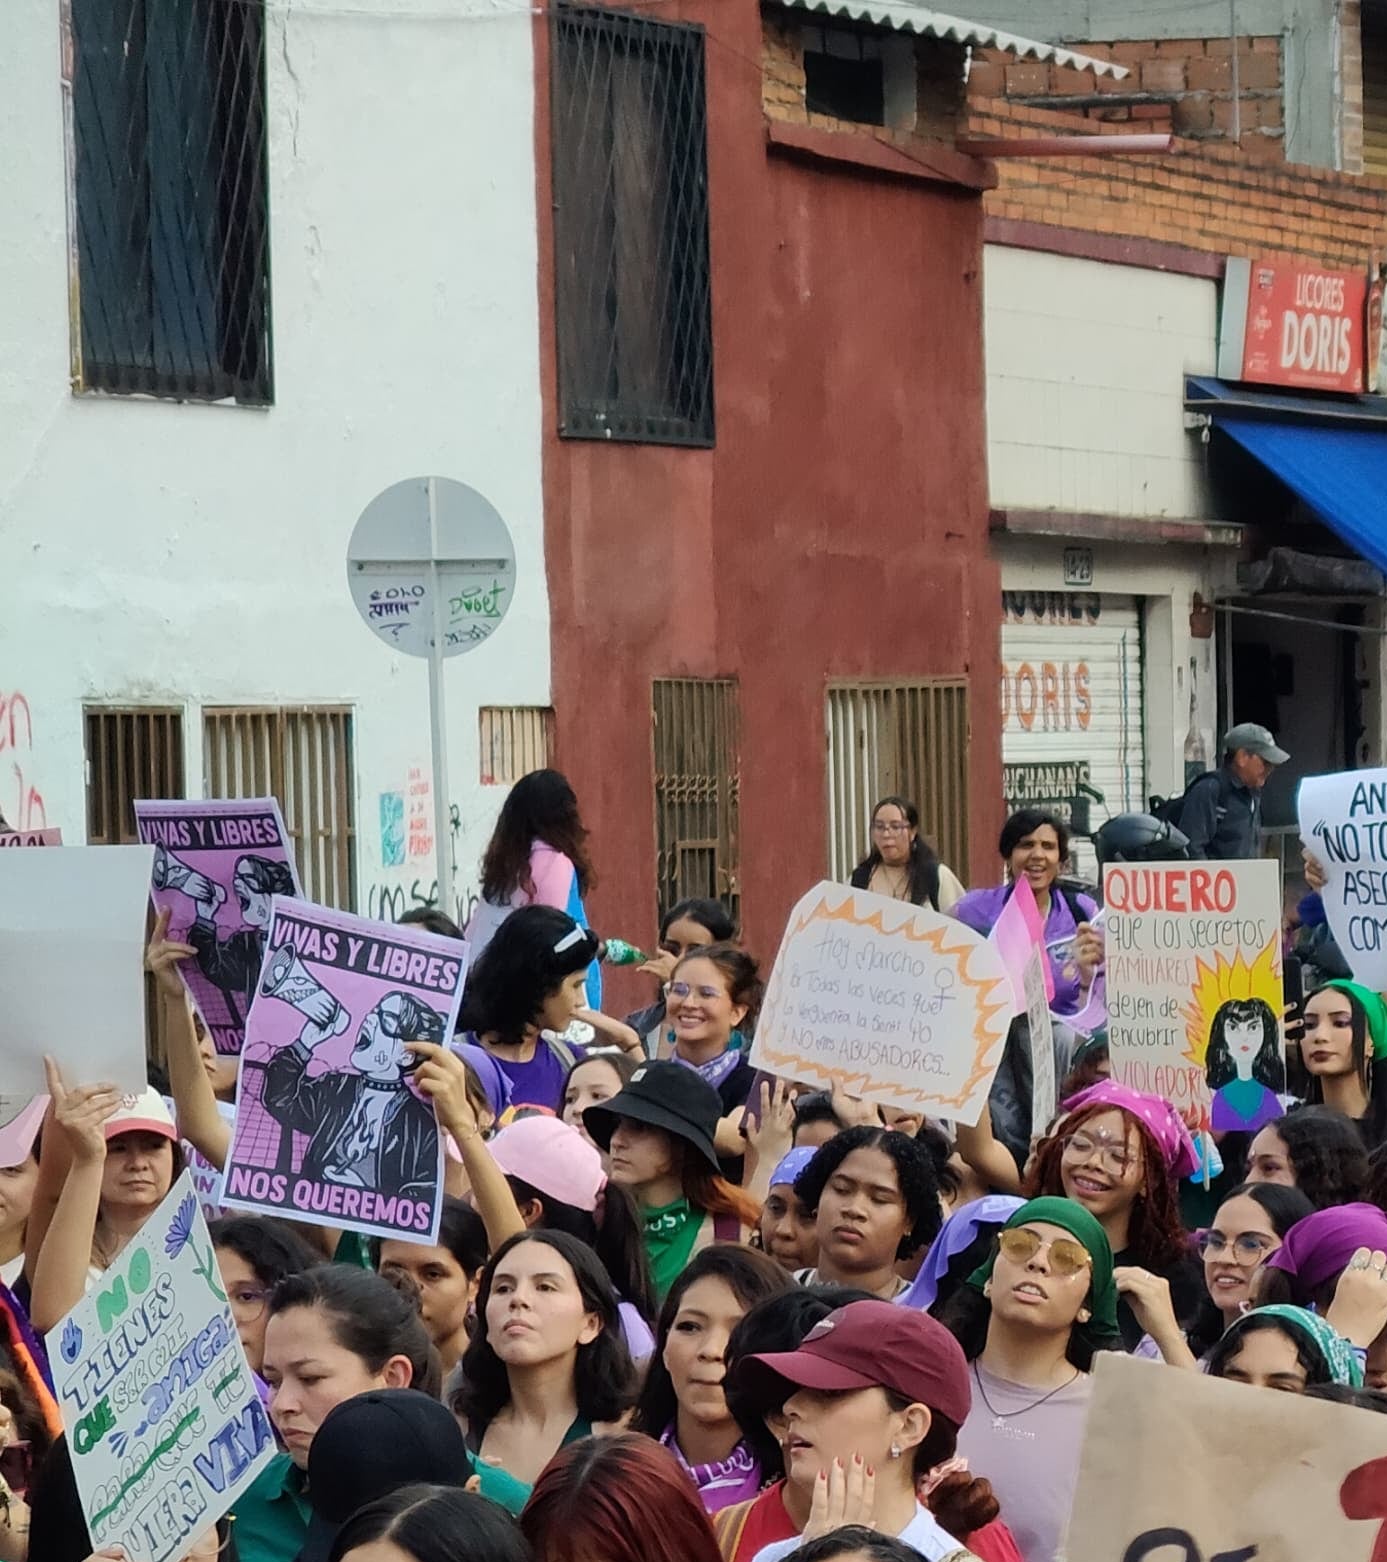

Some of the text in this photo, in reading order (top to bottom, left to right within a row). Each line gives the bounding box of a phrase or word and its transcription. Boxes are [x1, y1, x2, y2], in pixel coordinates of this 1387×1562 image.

[1295, 274, 1345, 313] LICORES
[1280, 310, 1352, 375] DORIS
[139, 817, 280, 846] VIVAS Y LIBRES
[1105, 868, 1237, 914] QUIERO
[273, 917, 461, 991] VIVAS Y LIBRES
[1107, 915, 1143, 951] que
[1108, 992, 1178, 1020] dejen de
[229, 1167, 286, 1202] NOS
[292, 1177, 432, 1231] QUEREMOS
[96, 1247, 151, 1334] NO
[62, 1272, 176, 1411] TIENES
[73, 1396, 117, 1456] QUE
[193, 1395, 273, 1495] VIVA
